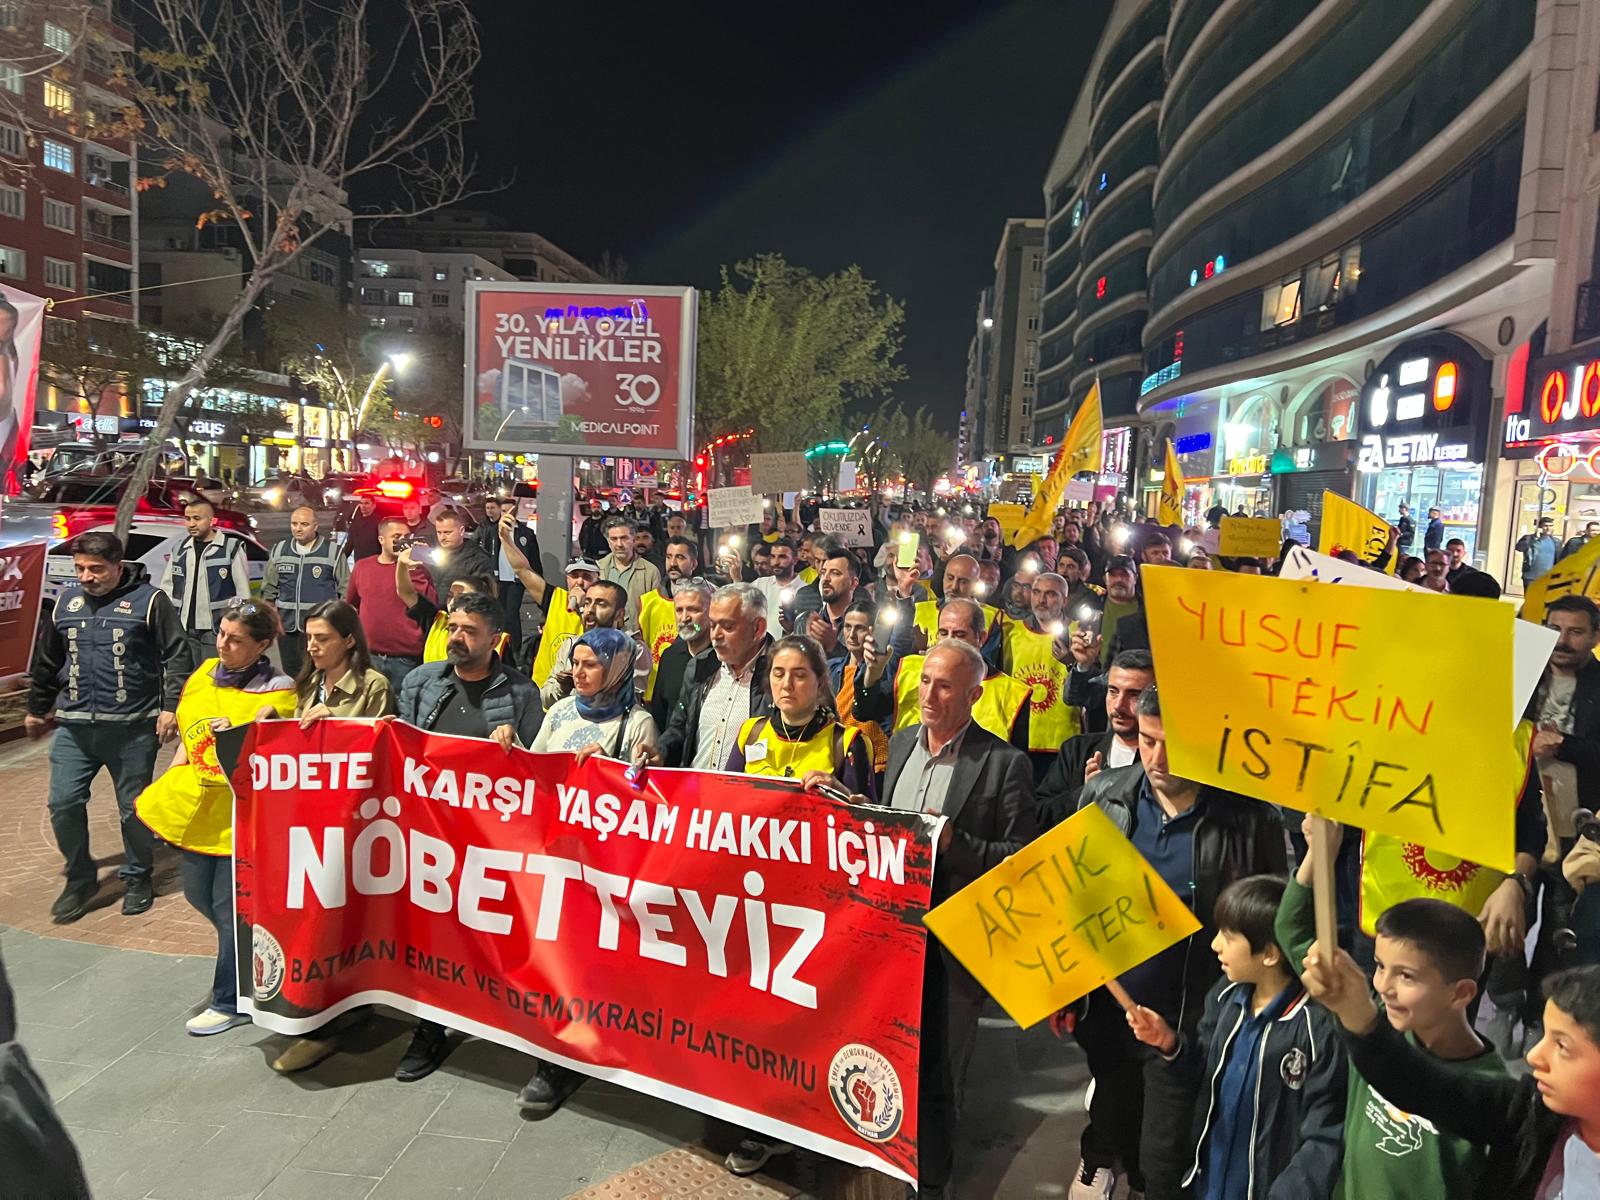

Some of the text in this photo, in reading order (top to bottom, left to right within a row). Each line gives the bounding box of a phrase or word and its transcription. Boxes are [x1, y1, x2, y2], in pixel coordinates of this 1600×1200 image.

[495, 313, 530, 334] 30.
[495, 336, 662, 364] YENİLİKLER
[1177, 596, 1361, 659] YUSUF
[403, 757, 536, 822] KARŞI
[555, 783, 680, 843] YAŞAM
[685, 808, 812, 865] HAKKI
[825, 814, 908, 886] İÇİN
[286, 795, 826, 1010] NÖBETTEYİZ
[975, 835, 1111, 958] ARTIK
[291, 939, 818, 1093] BATMAN EMEK VE DEMOKRASİ PLATFORMU
